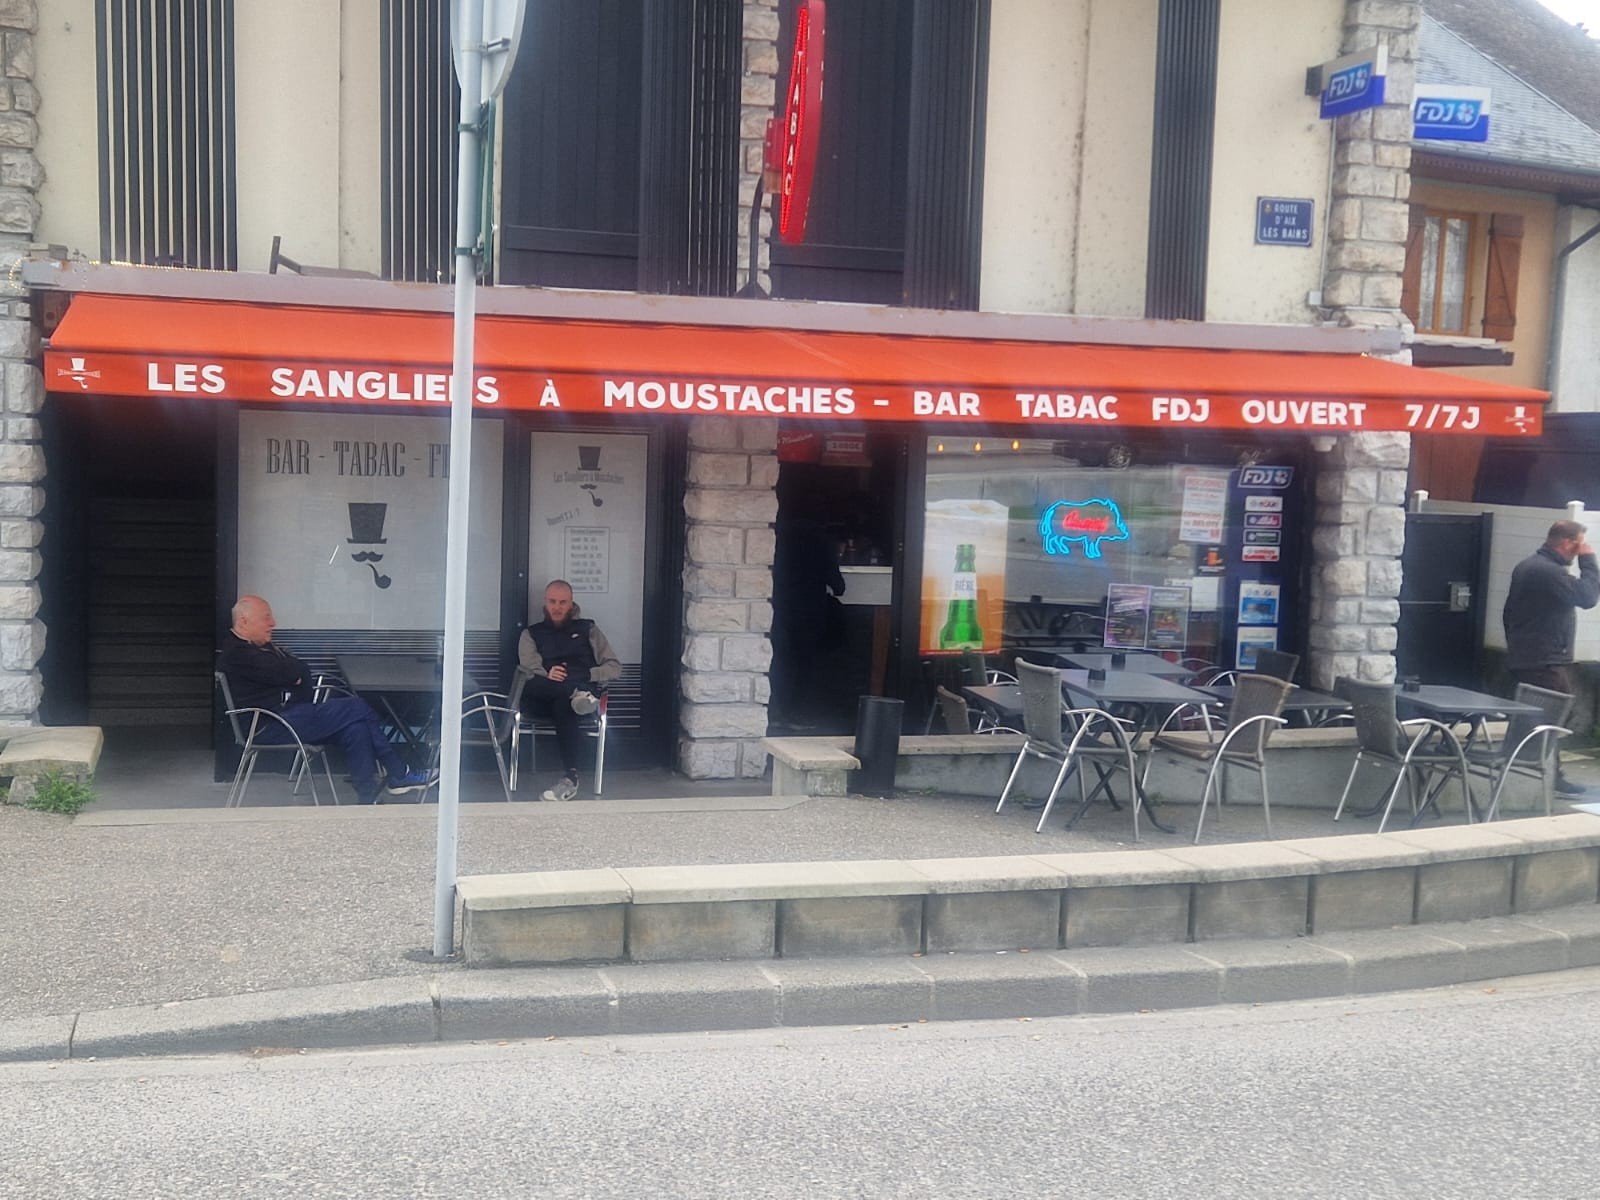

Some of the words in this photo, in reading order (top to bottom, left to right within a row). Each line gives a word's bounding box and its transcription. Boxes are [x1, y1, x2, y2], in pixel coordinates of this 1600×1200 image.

[1329, 74, 1355, 98] FDJ
[785, 51, 803, 195] TABAC
[1415, 102, 1455, 122] FDJ
[1274, 203, 1298, 214] ROUTE
[1263, 227, 1279, 238] LES
[1281, 228, 1308, 239] BAINS
[149, 363, 225, 393] LES
[539, 379, 560, 407] À
[605, 381, 855, 414] MOUSTACHES
[913, 390, 980, 416] BAR
[1016, 394, 1118, 419] TABAC
[1152, 398, 1210, 422] FDJ
[1242, 399, 1366, 426] OUVERT
[1406, 404, 1480, 429] 7/7J
[265, 438, 310, 474] BAR
[333, 440, 406, 477] TABAC
[1242, 470, 1273, 485] FDJ
